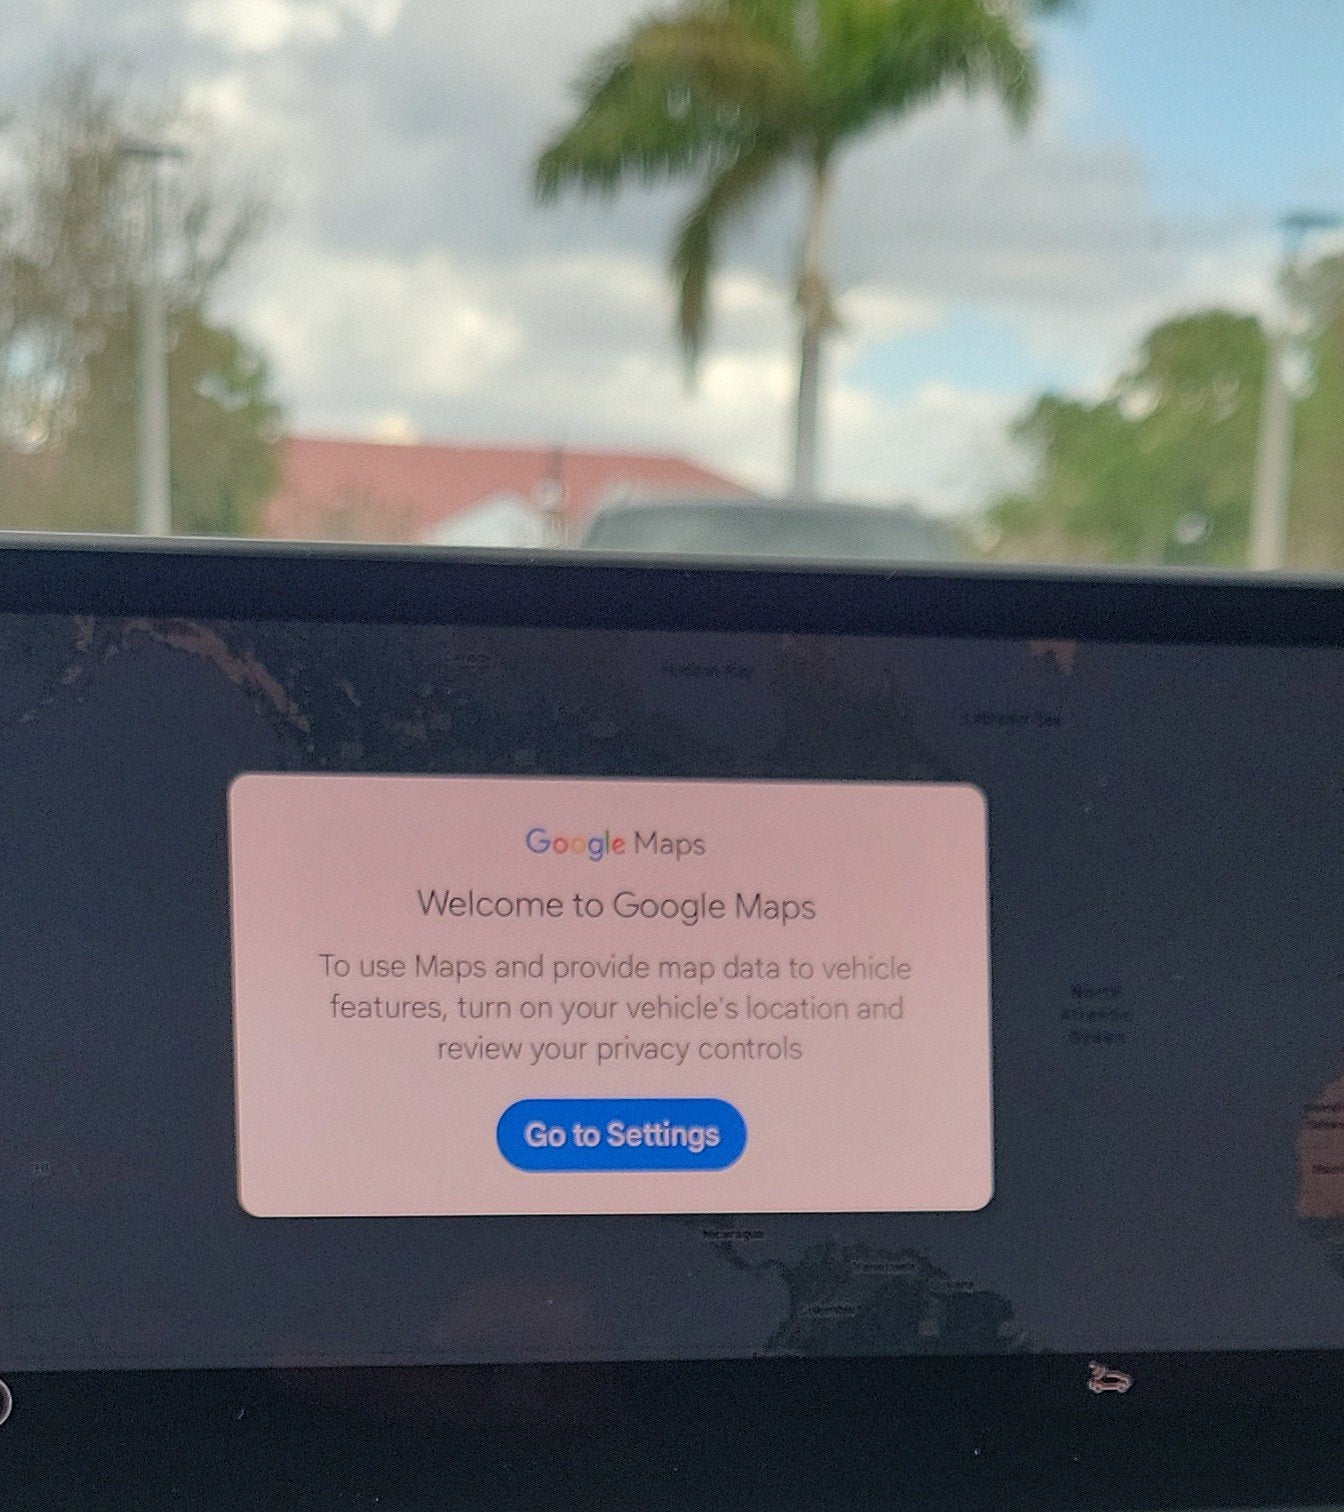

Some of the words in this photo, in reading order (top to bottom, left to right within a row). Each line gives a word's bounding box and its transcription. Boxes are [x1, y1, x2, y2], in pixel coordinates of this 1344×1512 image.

[525, 827, 625, 862] Google
[635, 831, 705, 860] Maps
[417, 890, 563, 917] Welcome
[573, 892, 605, 918] to
[613, 891, 725, 926] Google
[736, 892, 816, 925] Maps
[318, 953, 351, 979] To
[360, 960, 405, 977] use
[416, 954, 486, 982] Maps
[495, 954, 543, 978] and
[553, 954, 649, 983] provide
[659, 961, 715, 984] map
[723, 955, 779, 978] data
[789, 958, 813, 979] to
[823, 956, 911, 980] vehicle
[330, 993, 450, 1023] features,
[458, 996, 511, 1019] turn
[520, 1001, 552, 1018] on
[561, 1001, 618, 1025] your
[627, 995, 738, 1019] vehicle's
[747, 995, 848, 1019] location
[857, 996, 903, 1019] and
[438, 1035, 523, 1060] review
[531, 1042, 588, 1066] your
[598, 1035, 689, 1066] privacy
[698, 1036, 802, 1059] controls
[525, 1122, 565, 1147] Go
[573, 1124, 600, 1146] to
[608, 1121, 719, 1152] Settings
